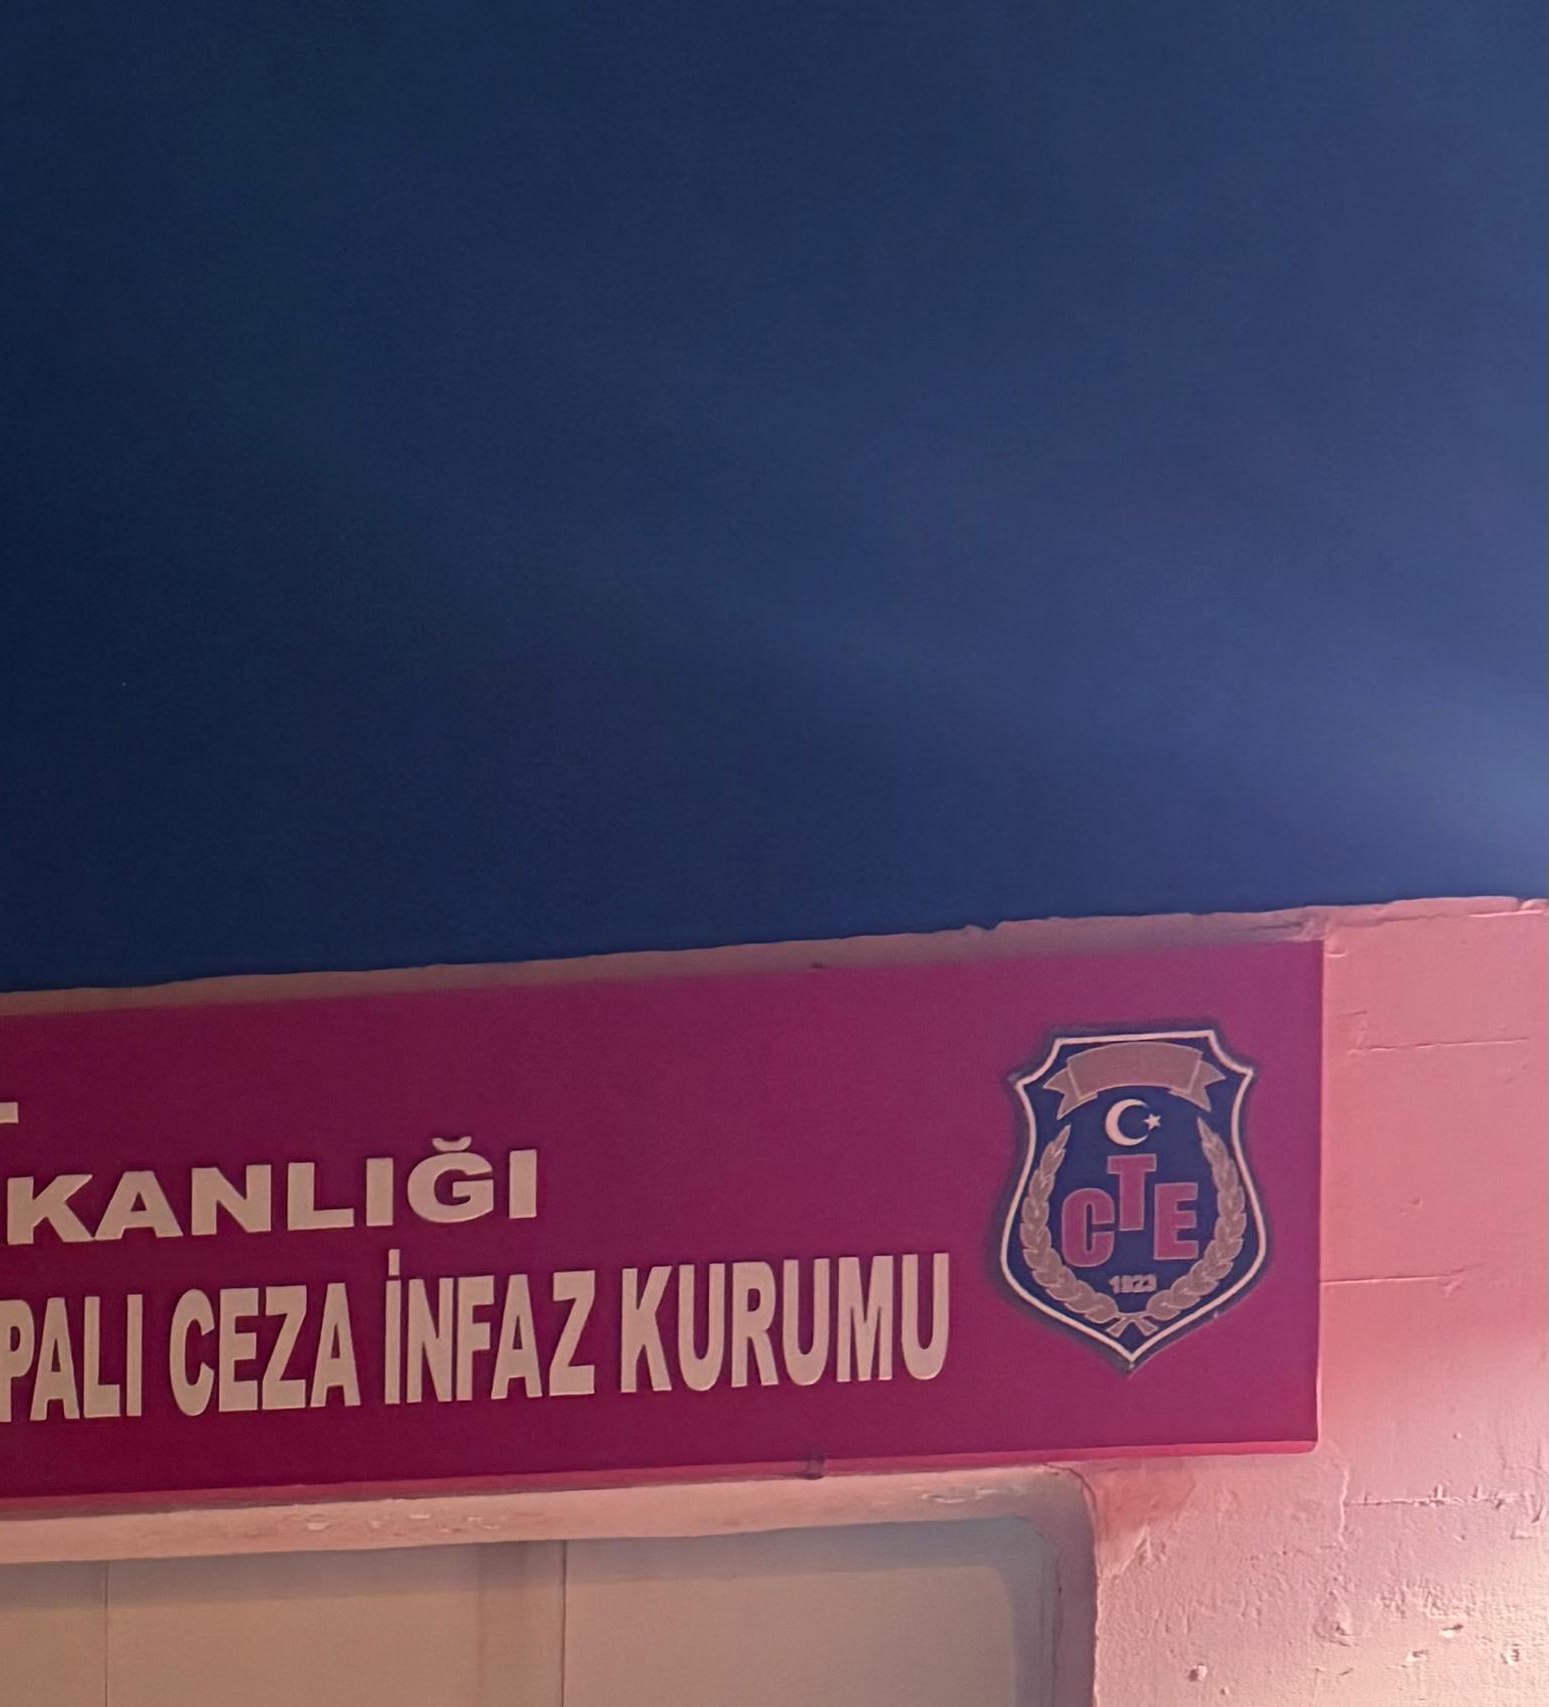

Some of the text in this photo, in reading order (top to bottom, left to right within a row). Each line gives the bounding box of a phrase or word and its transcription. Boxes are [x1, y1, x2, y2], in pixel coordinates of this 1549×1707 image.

[1061, 1154, 1199, 1268] CTE
[168, 1282, 362, 1417] CEZA
[383, 1248, 596, 1406] İNFAZ
[620, 1252, 952, 1395] KURUMU
